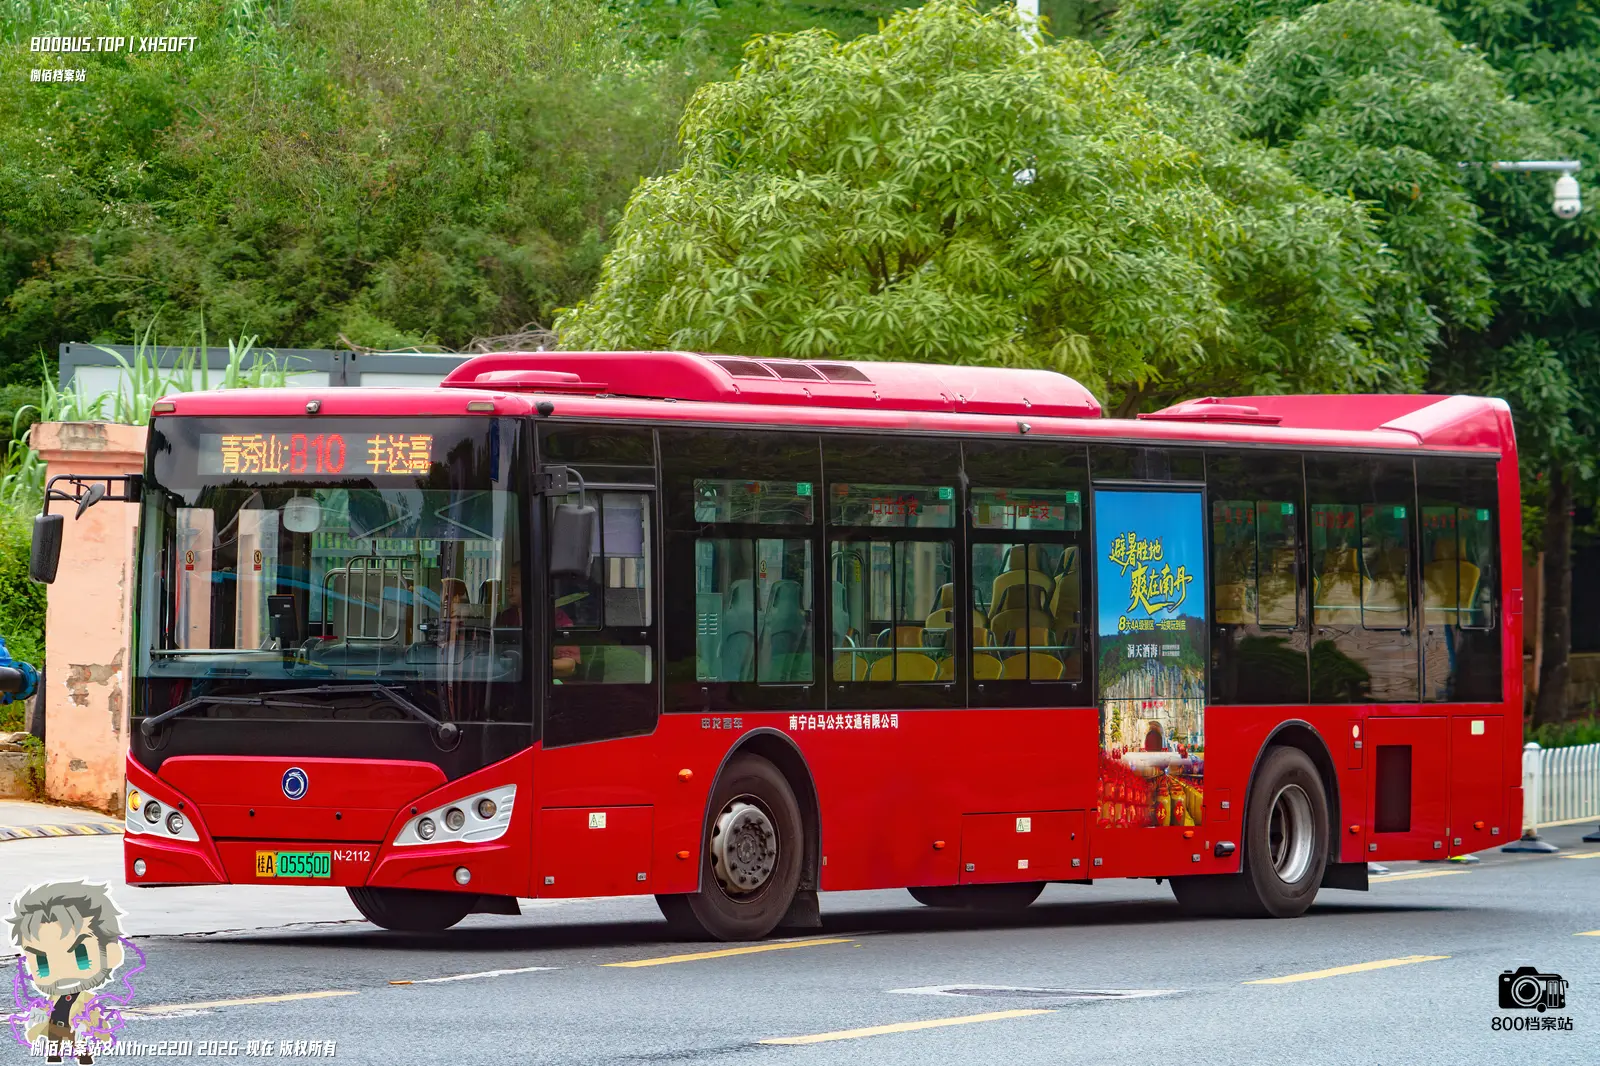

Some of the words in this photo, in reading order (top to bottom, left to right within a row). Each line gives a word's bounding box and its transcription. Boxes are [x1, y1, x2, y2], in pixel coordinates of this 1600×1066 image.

[1126, 562, 1193, 615] 爽在南丹
[789, 713, 899, 731] 南宁白马公共交通有限公司
[333, 849, 371, 862] N-2112
